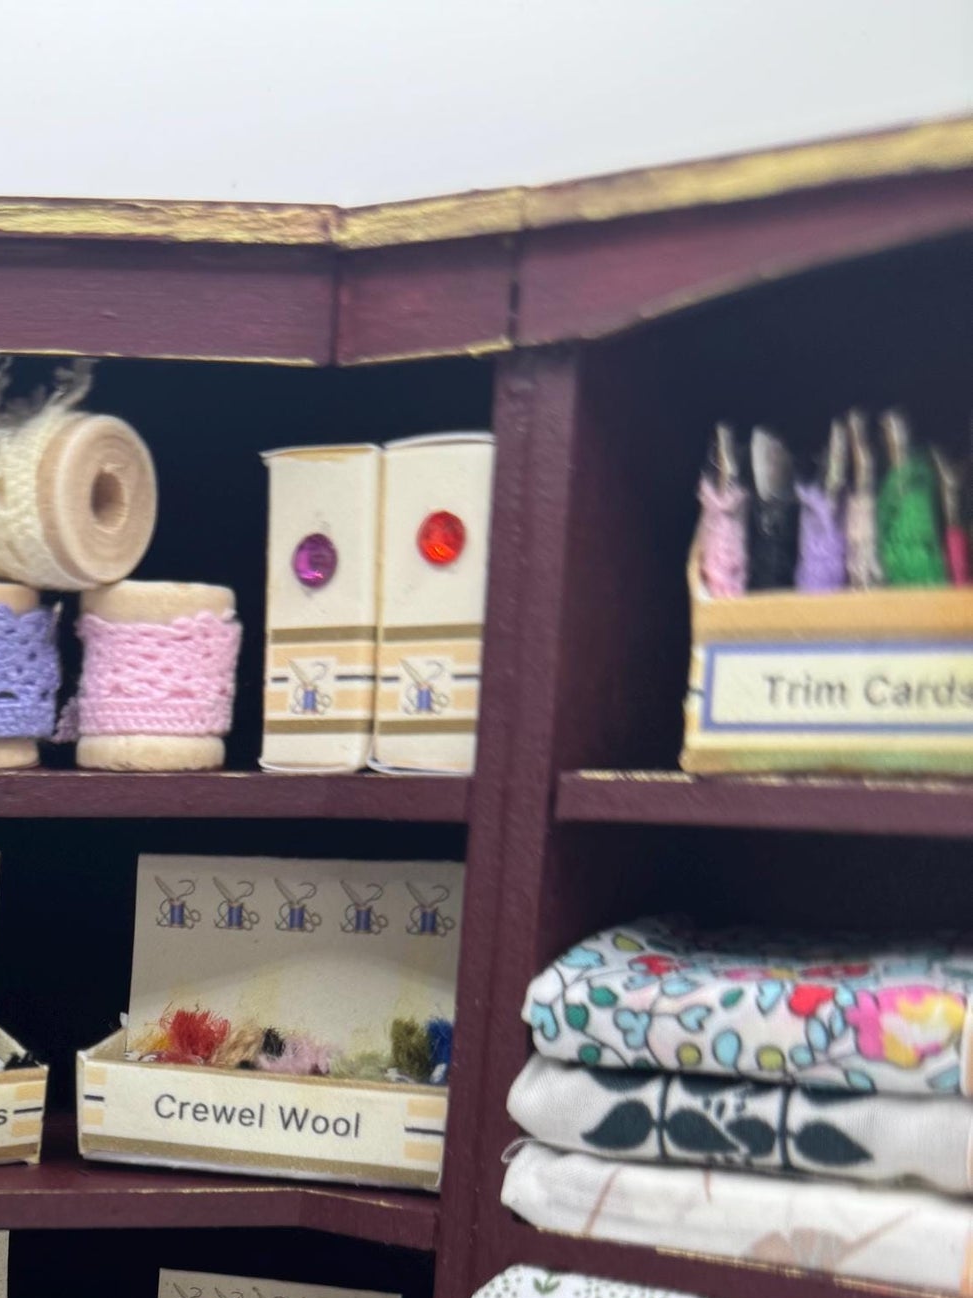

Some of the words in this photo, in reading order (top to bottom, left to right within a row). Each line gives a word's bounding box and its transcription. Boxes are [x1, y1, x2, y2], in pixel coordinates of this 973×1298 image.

[761, 673, 847, 705] Trim
[864, 672, 973, 707] Cards
[154, 1093, 265, 1129] Crewel
[279, 1105, 361, 1138] Wool
